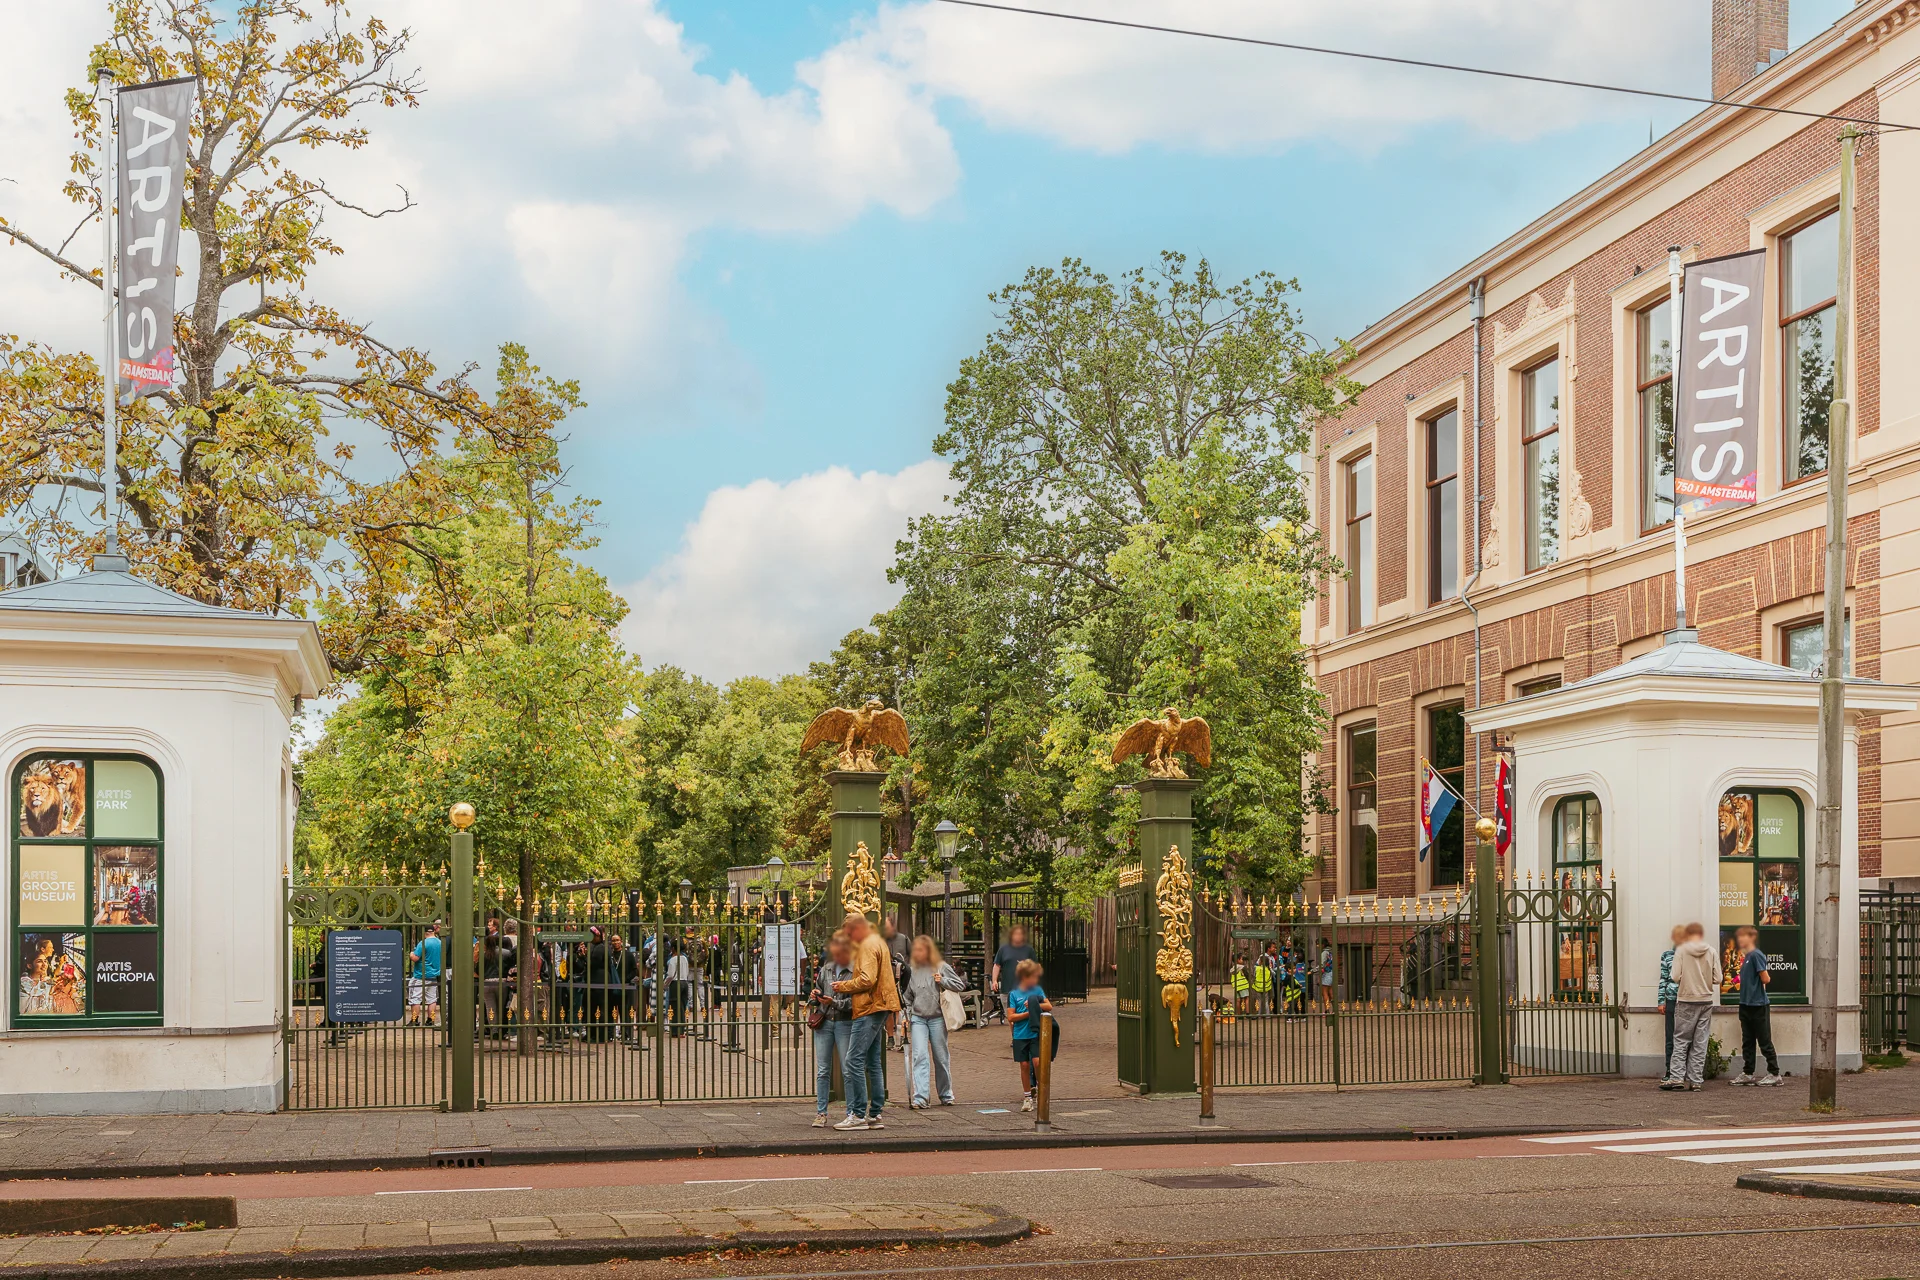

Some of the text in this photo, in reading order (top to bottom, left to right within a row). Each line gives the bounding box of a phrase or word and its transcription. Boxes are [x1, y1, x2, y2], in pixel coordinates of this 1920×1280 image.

[127, 106, 176, 359] ARTIS
[1690, 276, 1750, 482] ARTIS
[1676, 481, 1694, 493] 750
[1700, 486, 1756, 500] AMSTERDAM
[96, 789, 132, 799] ARTIS
[96, 800, 128, 810] PARK
[1760, 818, 1784, 826] ARTIS
[1760, 826, 1782, 835] PARK
[22, 870, 58, 880] ARTIS
[22, 881, 76, 891] GROOTE
[1719, 883, 1738, 891] RTIS
[22, 891, 76, 902] MUSEUM
[1767, 954, 1784, 962] RTIS
[96, 961, 132, 971] ARTIS
[1766, 962, 1798, 970] ICROPIA
[96, 972, 156, 982] MICROPIA
